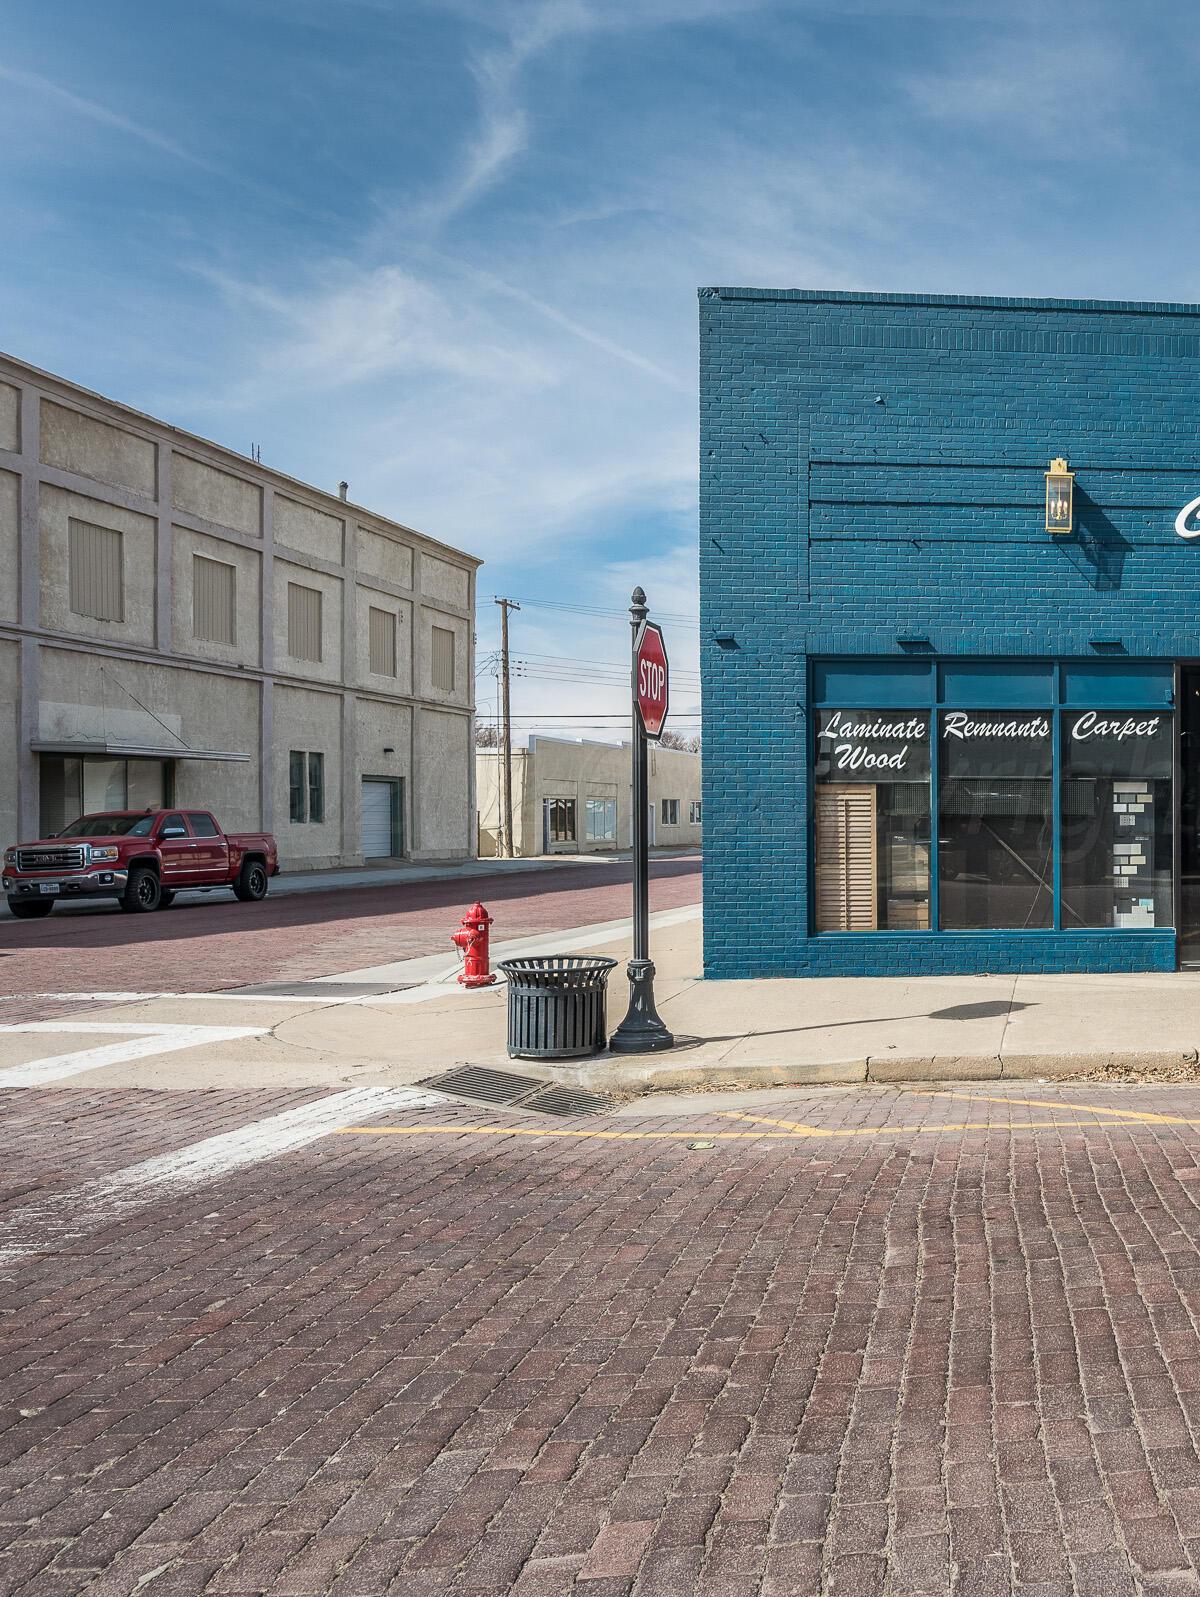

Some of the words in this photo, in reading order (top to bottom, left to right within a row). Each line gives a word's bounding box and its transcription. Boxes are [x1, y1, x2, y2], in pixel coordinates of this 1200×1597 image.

[639, 658, 665, 702] STOP
[817, 711, 926, 739] Laminate
[943, 711, 1051, 739] Remnants
[1072, 711, 1160, 741] Carpet
[834, 743, 909, 770] Wood
